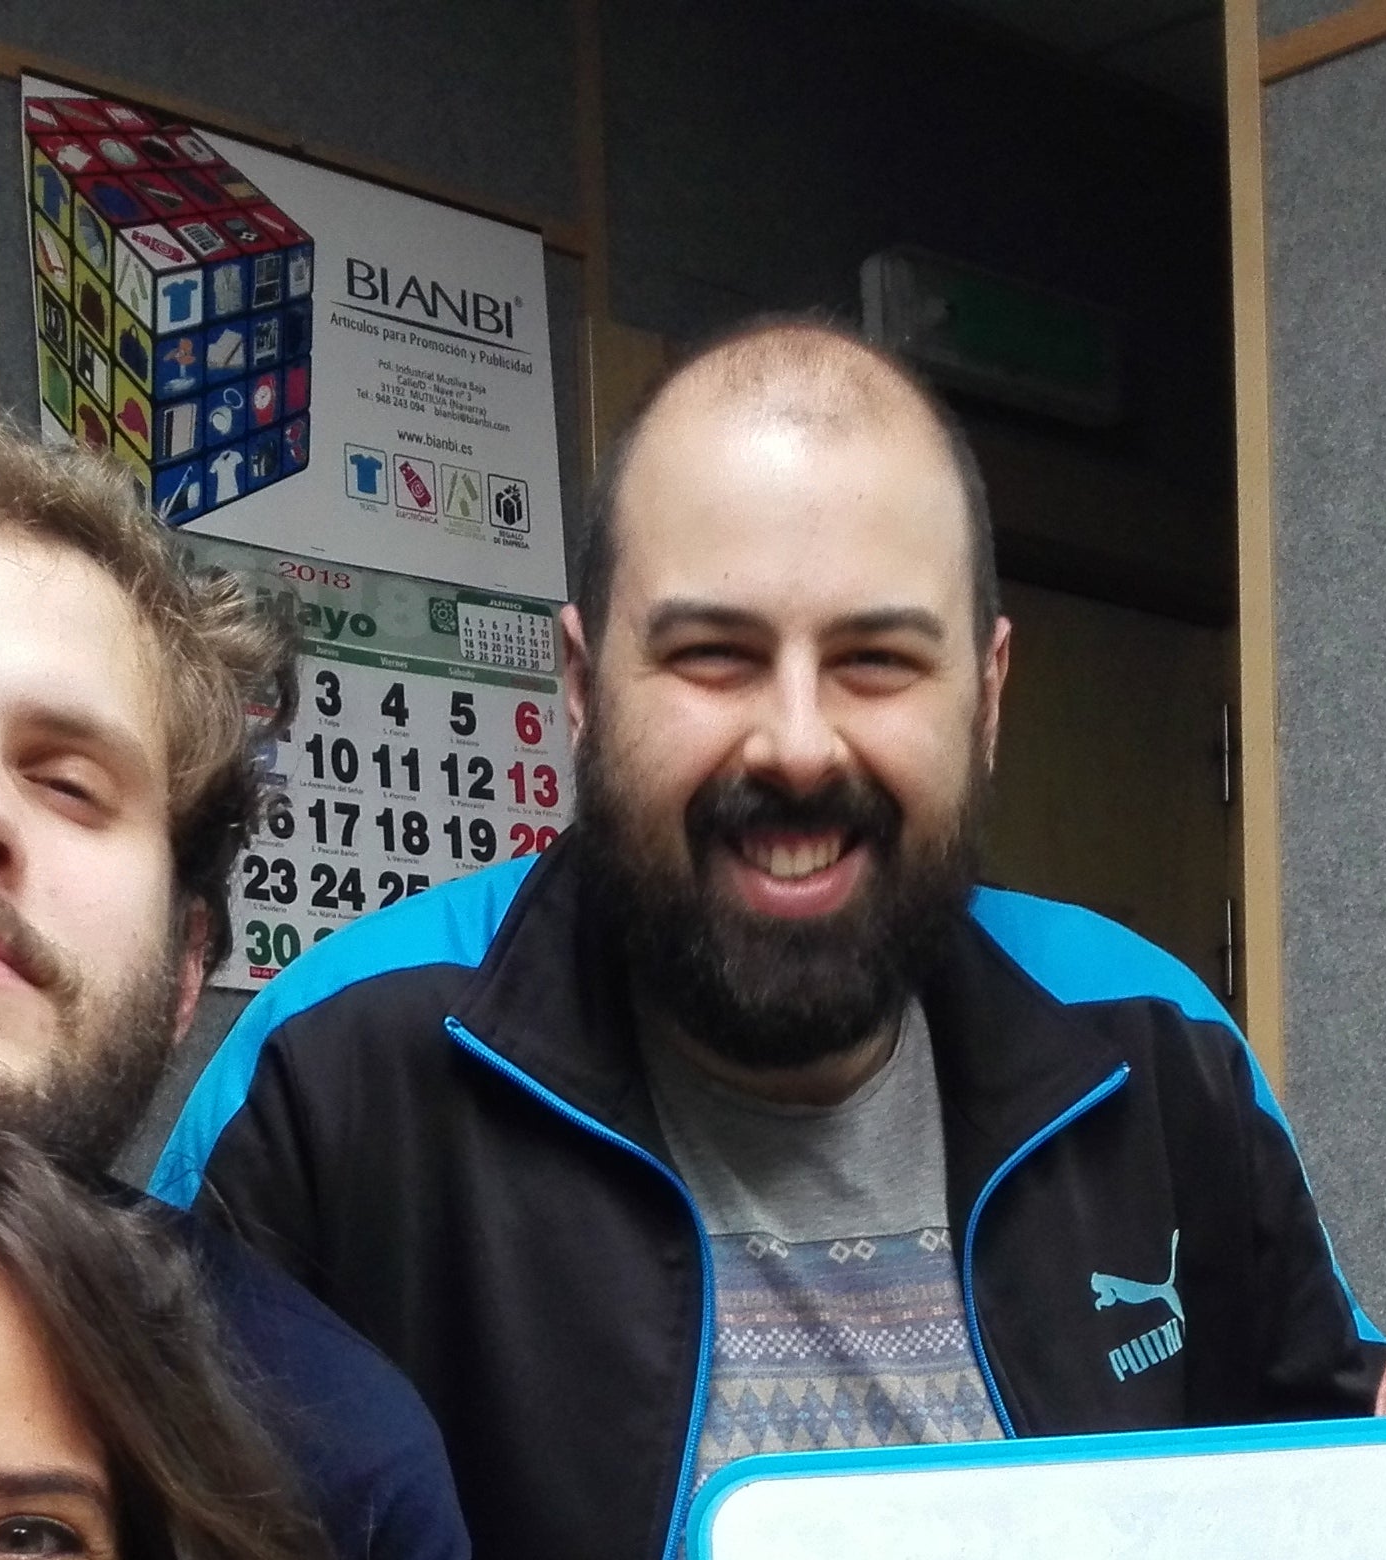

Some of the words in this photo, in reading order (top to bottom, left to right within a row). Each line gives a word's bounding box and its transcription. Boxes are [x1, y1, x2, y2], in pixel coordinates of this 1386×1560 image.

[347, 257, 512, 338] BIANBI
[383, 327, 407, 345] para
[470, 351, 476, 364] y
[480, 350, 533, 375] Publicidad
[396, 363, 434, 381] Industrial
[397, 429, 473, 456] www.bianbi.es
[279, 561, 351, 590] 2018
[489, 600, 522, 610] JUNIO
[381, 656, 408, 669] Viernes
[315, 670, 342, 716] 3
[381, 682, 409, 727] 4
[449, 691, 477, 736] 5
[515, 701, 542, 745] 6
[305, 733, 359, 784] 10
[372, 744, 420, 792] 11
[440, 752, 495, 800] 12
[507, 761, 559, 808] 13
[308, 799, 361, 847] 17
[376, 808, 430, 856] 18
[443, 816, 497, 862] 19
[509, 822, 559, 860] 20
[243, 854, 298, 904] 23
[311, 863, 366, 912] 24
[245, 920, 301, 968] 30
[1109, 1317, 1183, 1382] PUMA
